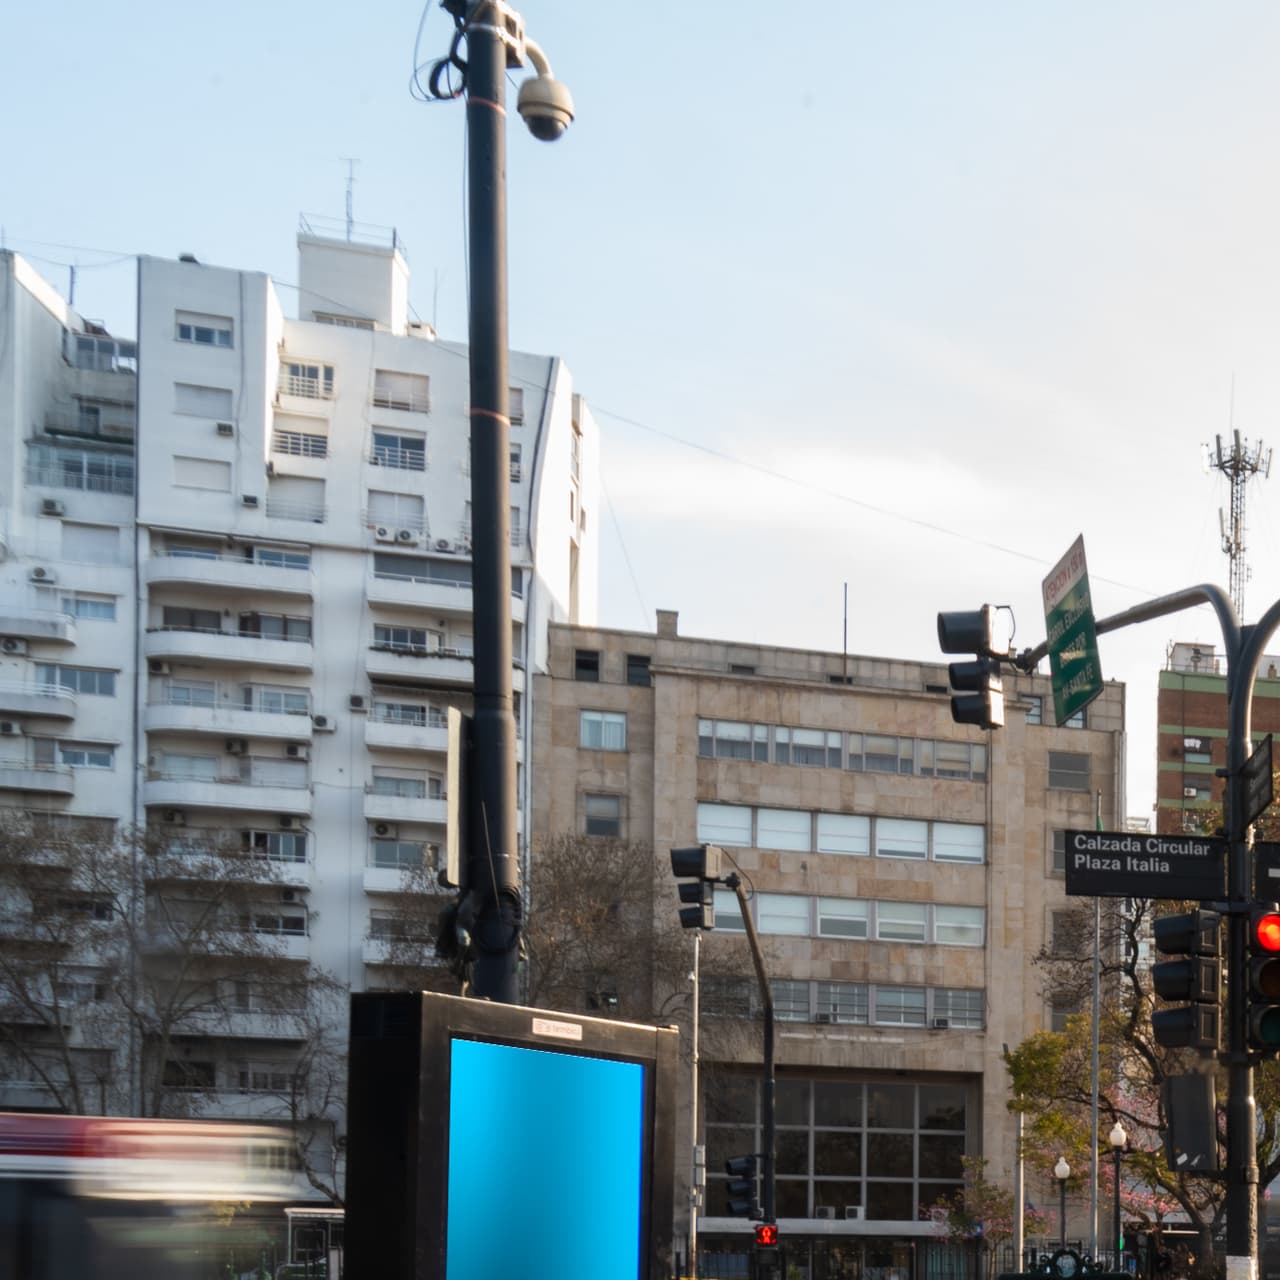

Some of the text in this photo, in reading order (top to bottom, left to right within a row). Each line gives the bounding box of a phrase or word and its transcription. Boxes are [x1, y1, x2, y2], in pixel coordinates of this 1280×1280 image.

[1074, 835, 1211, 856] Calzada Circular
[1074, 854, 1170, 874] Plaza Italia
